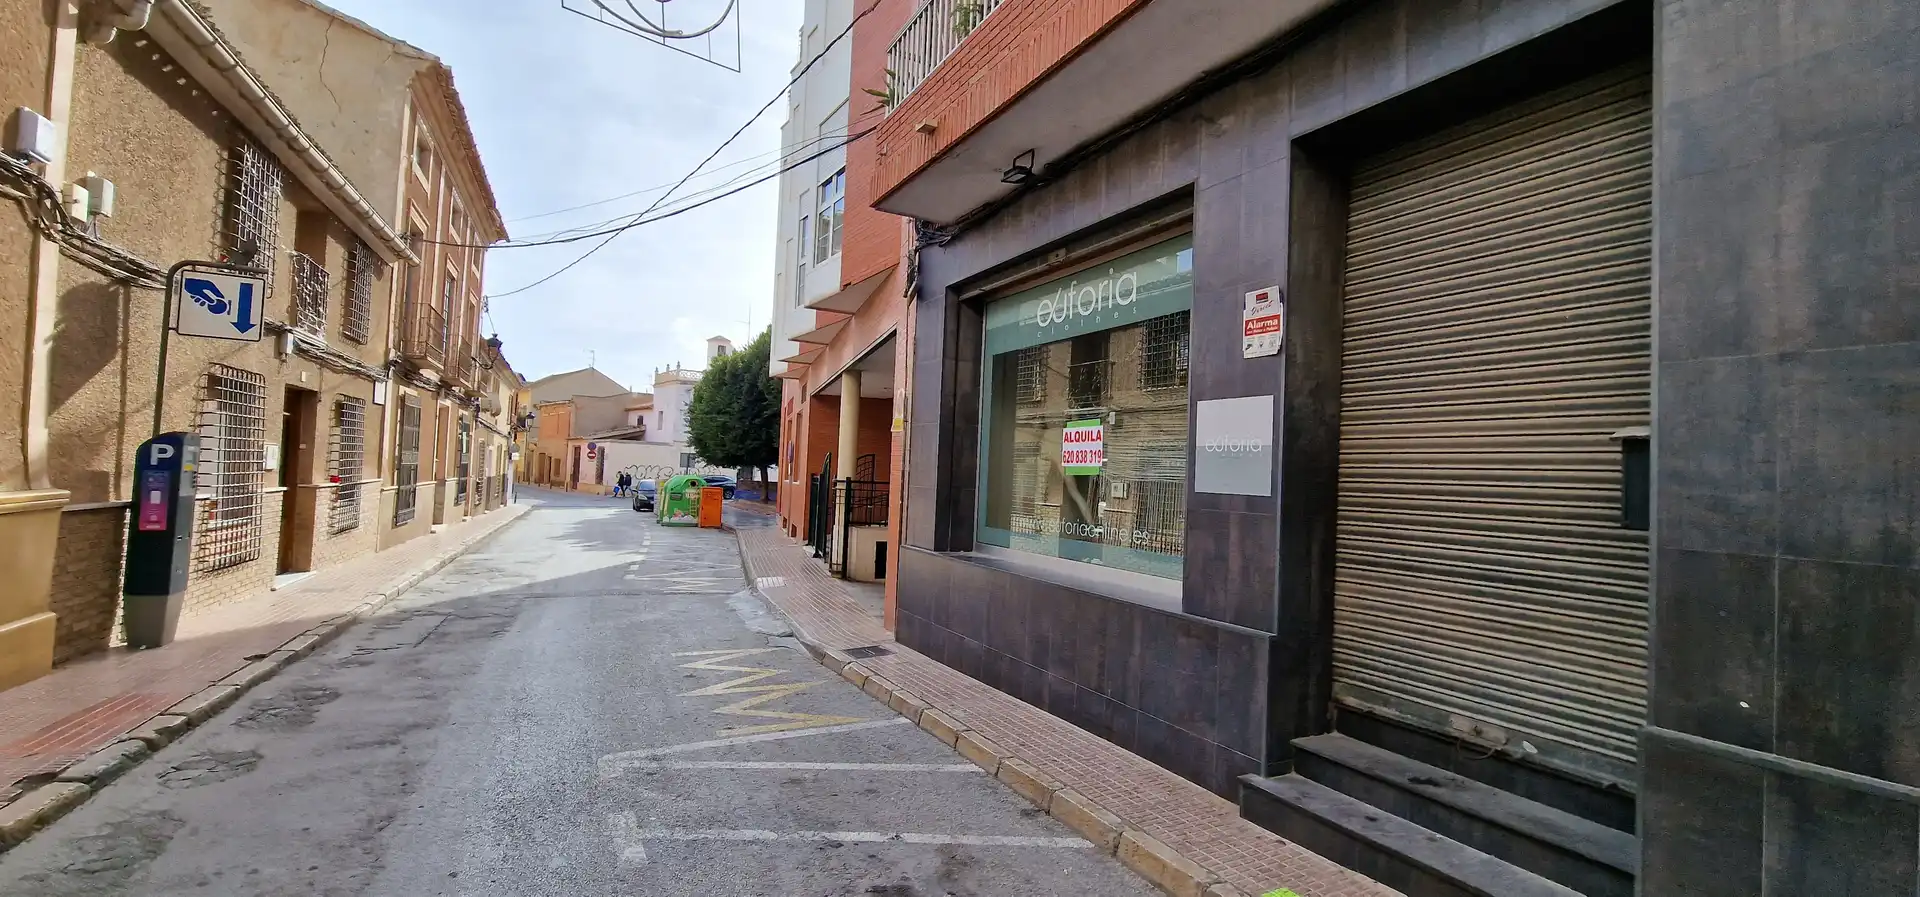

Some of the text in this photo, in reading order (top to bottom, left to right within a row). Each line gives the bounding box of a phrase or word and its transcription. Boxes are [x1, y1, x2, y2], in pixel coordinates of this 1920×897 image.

[1037, 305, 1137, 338] clothes
[1247, 318, 1278, 330] Alarma
[1063, 429, 1102, 443] ALQUILA
[150, 443, 175, 466] P
[1062, 449, 1102, 464] 620 838 319
